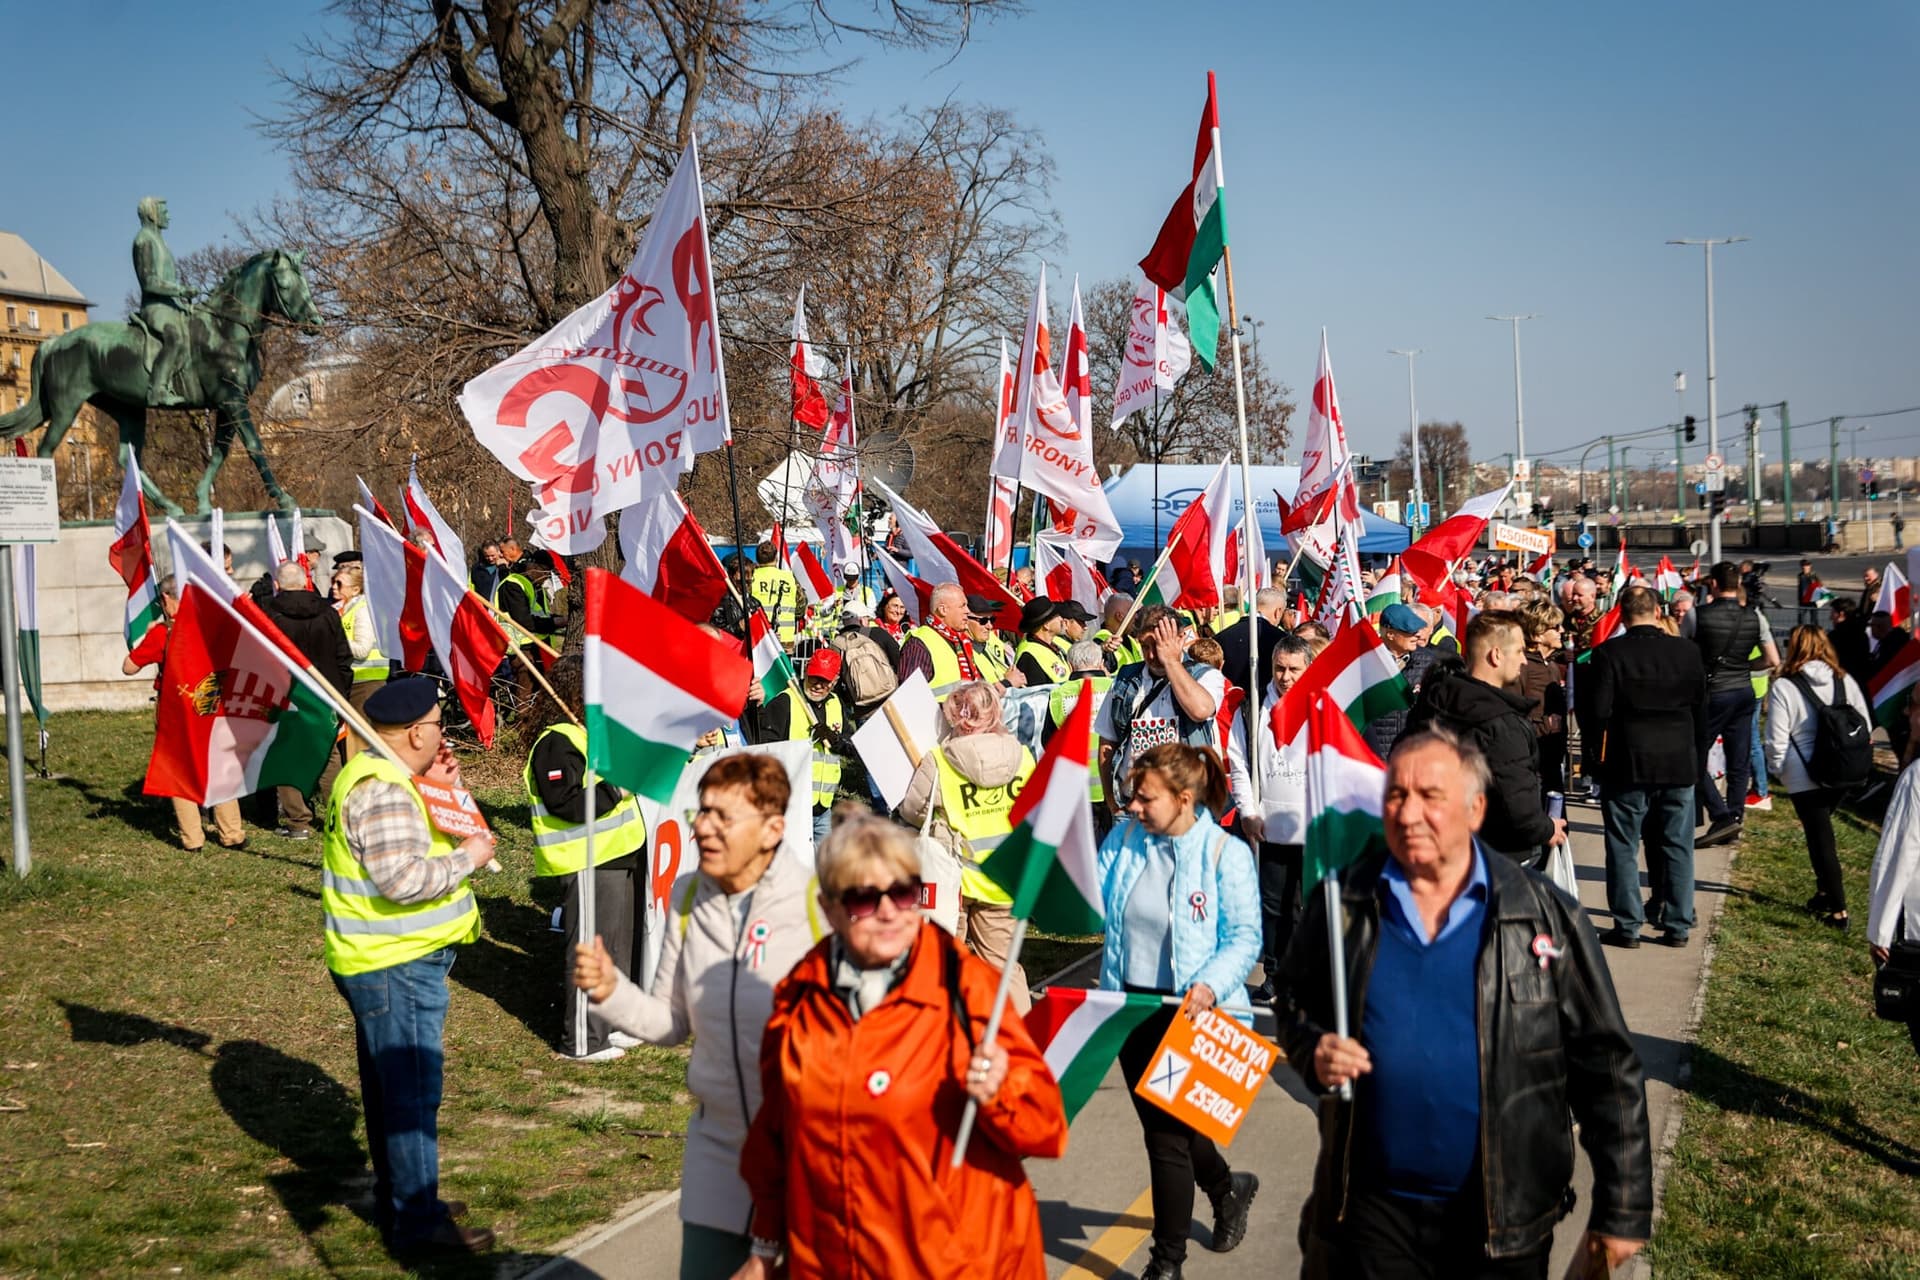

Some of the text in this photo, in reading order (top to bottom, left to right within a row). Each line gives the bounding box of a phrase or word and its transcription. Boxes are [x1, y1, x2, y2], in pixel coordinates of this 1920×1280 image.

[1500, 527, 1544, 549] CSORNA
[1190, 1033, 1262, 1092] A BIZTOS
[1191, 1009, 1270, 1071] VÁLASZTÁ
[1184, 1079, 1243, 1129] FIDESZ
